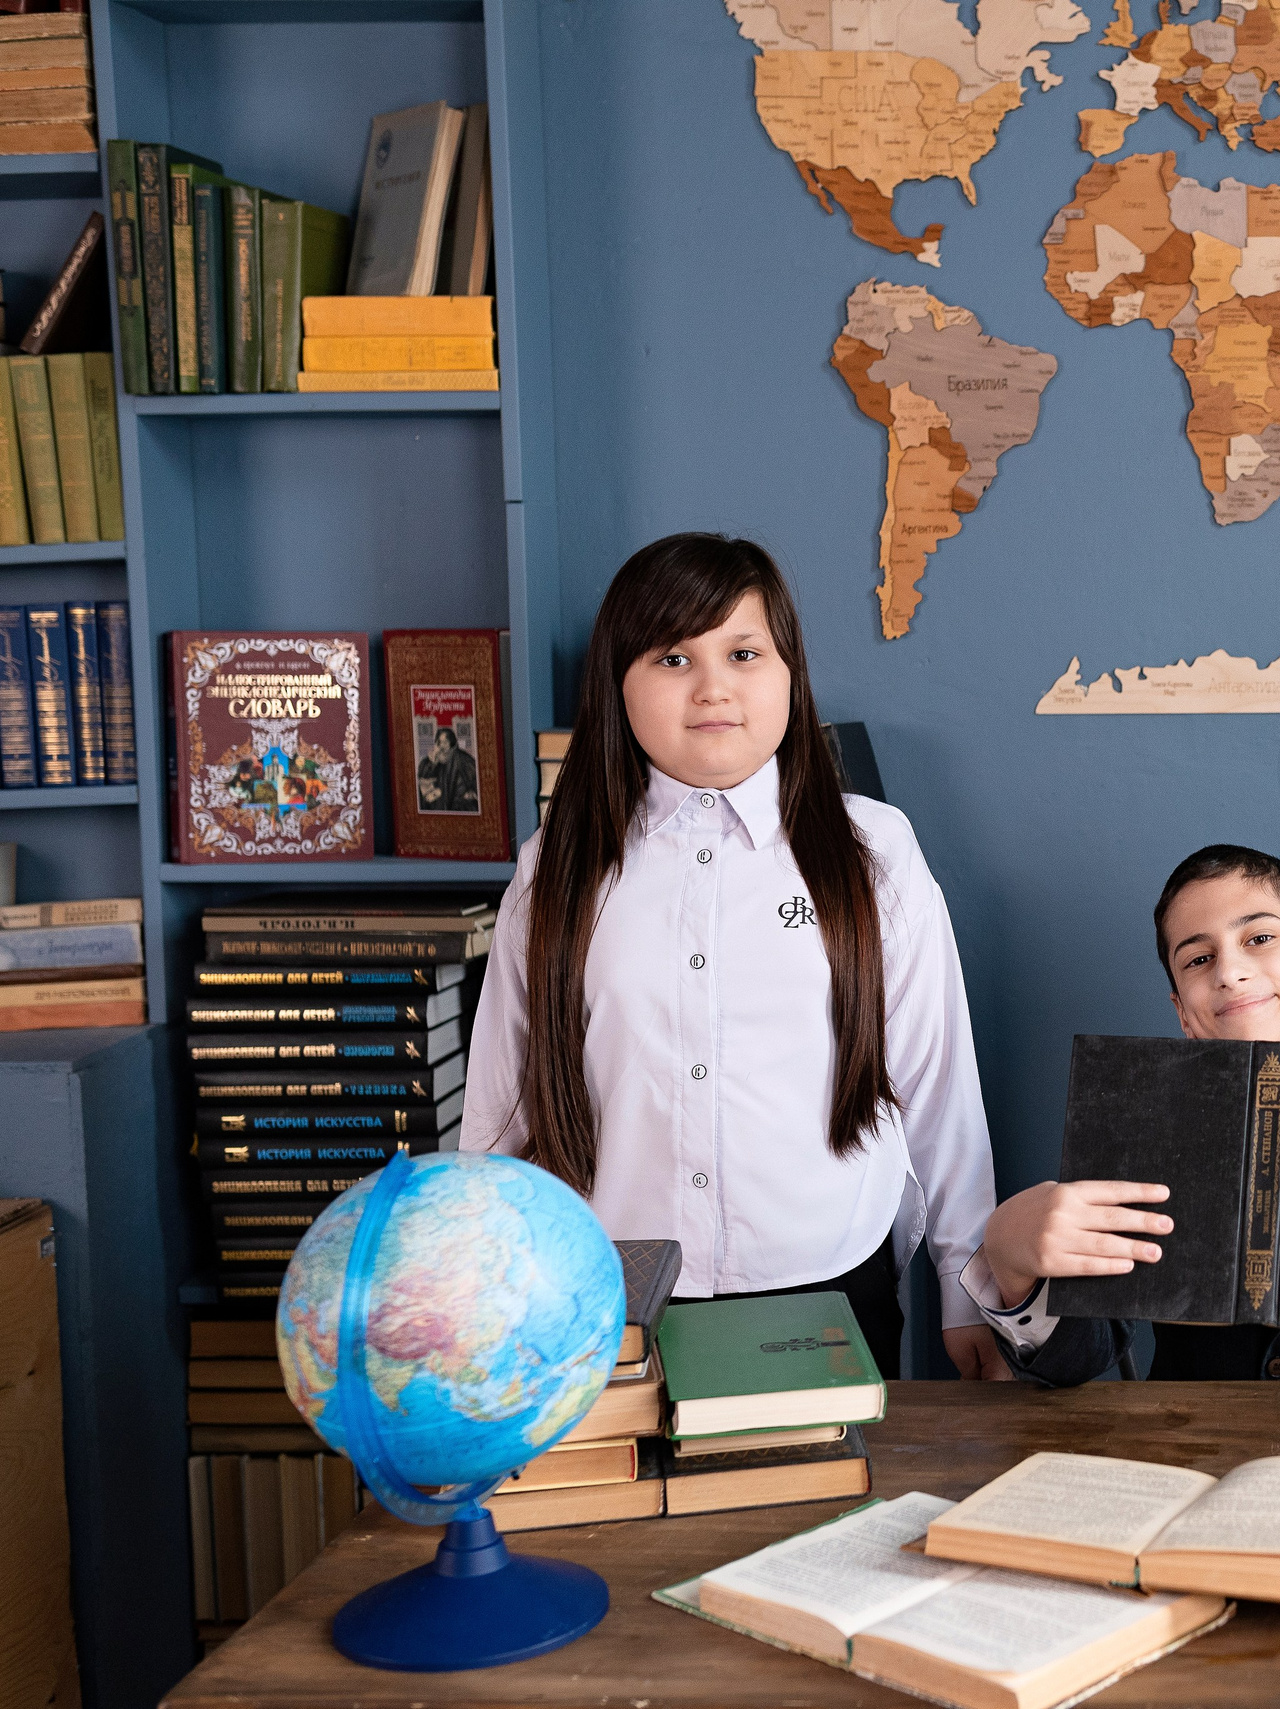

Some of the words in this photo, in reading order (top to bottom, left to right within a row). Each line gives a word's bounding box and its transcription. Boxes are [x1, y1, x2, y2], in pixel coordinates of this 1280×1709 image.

[837, 85, 897, 113] США
[947, 375, 1009, 396] Бразилия
[901, 523, 949, 539] Аргентина
[216, 673, 332, 686] ИЛЛЮСТРИРОВАННЫЙ
[206, 685, 342, 699] ЭНЦИКЛОПЕДИЧЕСКИЙ
[228, 699, 321, 719] СЛОВАРЬ
[199, 972, 284, 985] ЭНЦИКЛОПЕДИЯ
[287, 972, 308, 985] ДЛЯ
[311, 970, 344, 984] ДЕТЕЙ
[191, 1010, 276, 1022] ЭНЦИКЛОПЕДИЯ
[278, 1009, 300, 1021] ДЛЯ
[303, 1007, 336, 1021] ДЕТЕЙ
[191, 1046, 276, 1060] ЭНЦИКЛОПЕДИЯ
[278, 1046, 300, 1058] ДЛЯ
[303, 1043, 336, 1058] ДЕТЕЙ
[199, 1084, 283, 1097] ЭНЦИКЛОПЕДИЯ
[286, 1084, 307, 1096] ДЛЯ
[310, 1082, 343, 1096] ДЕТЕЙ
[350, 1085, 407, 1096] ТЕХНИКА
[254, 1117, 309, 1129] ИСТОРИЯ
[315, 1116, 383, 1128] ИСКУССТВА
[1261, 1110, 1274, 1164] СТЕПАНОВ
[257, 1148, 312, 1160] ИСТОРИЯ
[318, 1147, 386, 1159] ИСКУССТВА
[1261, 1166, 1270, 1176] А.
[306, 1180, 329, 1192] ДЛЯ
